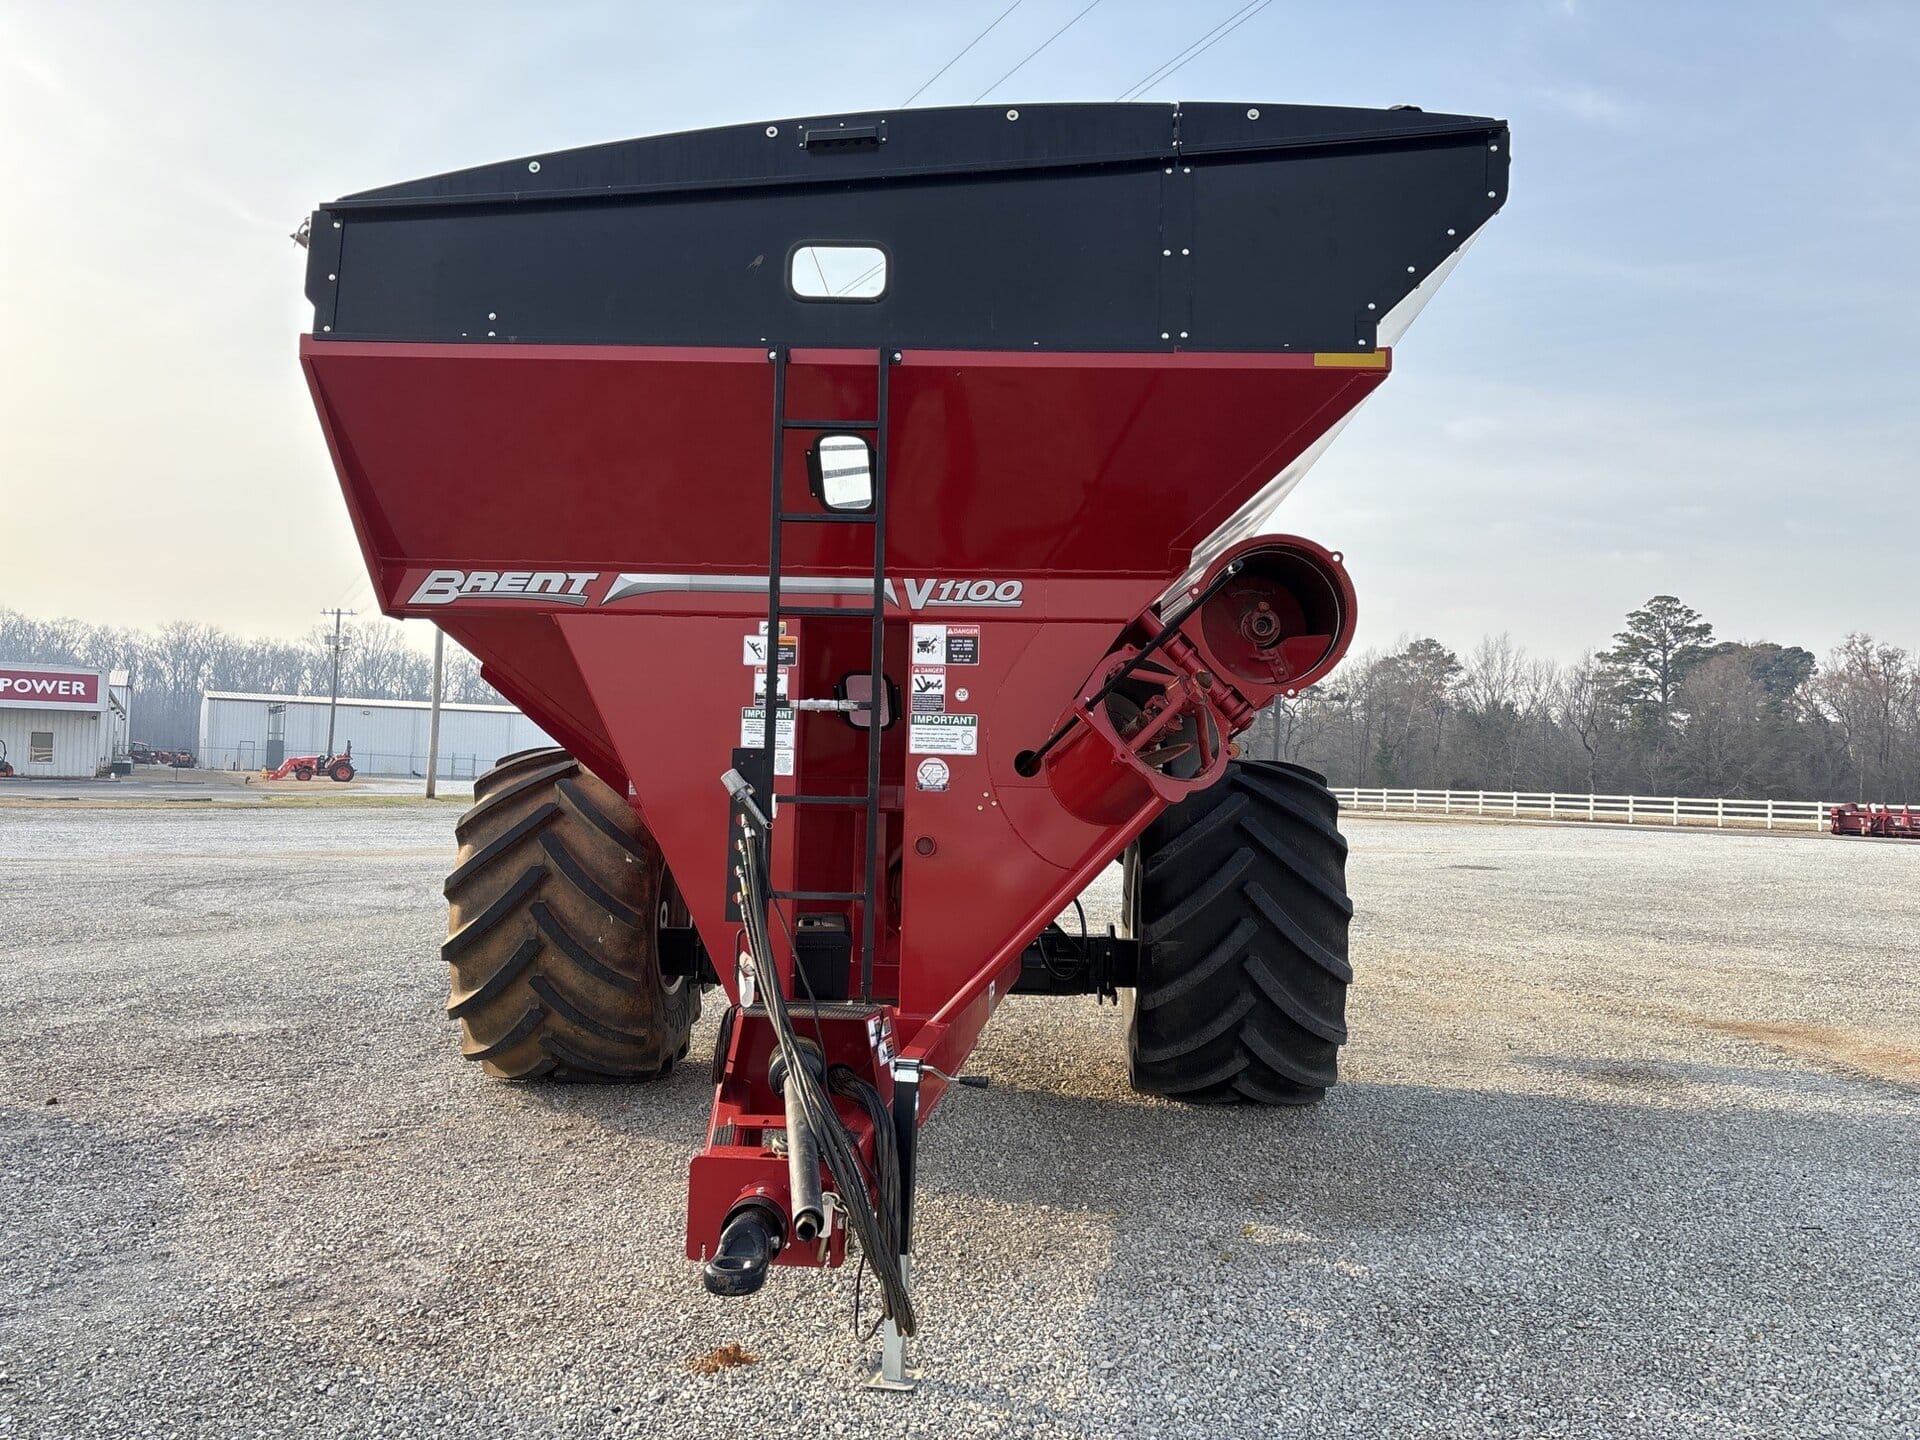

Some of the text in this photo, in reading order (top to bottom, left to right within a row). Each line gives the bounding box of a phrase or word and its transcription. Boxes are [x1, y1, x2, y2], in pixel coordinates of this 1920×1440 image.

[406, 569, 600, 605] BRENT
[902, 577, 1023, 610] V1100
[953, 627, 978, 635] DANGER
[0, 677, 86, 696] POWER
[744, 709, 793, 719] IMPOANT
[914, 715, 974, 725] IMPORTANT
